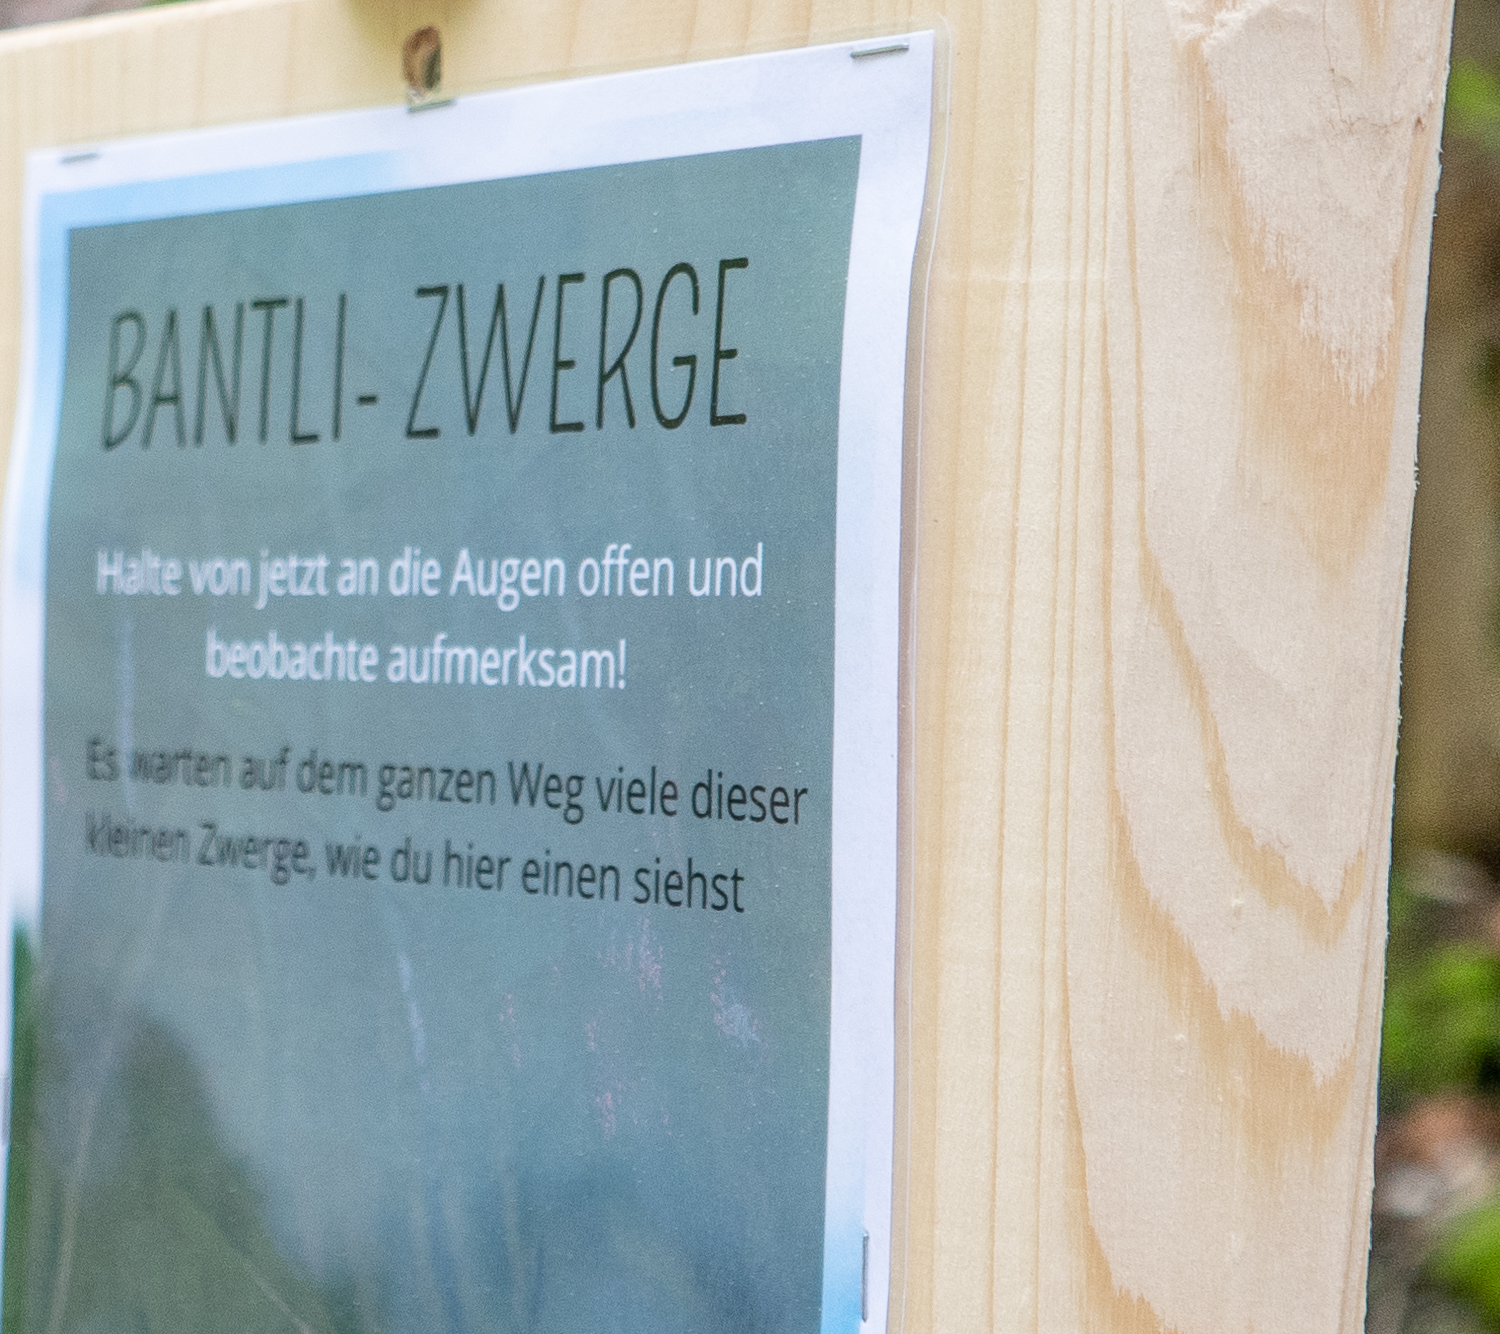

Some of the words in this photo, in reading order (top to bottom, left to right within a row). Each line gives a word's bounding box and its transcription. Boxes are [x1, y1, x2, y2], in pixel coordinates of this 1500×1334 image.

[405, 256, 750, 439] ZWERGE
[95, 544, 184, 597] Halte
[189, 557, 250, 597] von
[253, 544, 330, 610] jetzt
[337, 556, 380, 597] an
[389, 544, 443, 597] die
[449, 547, 567, 612] Augen
[576, 542, 676, 598] offen
[687, 539, 764, 598] und
[204, 624, 380, 682] beobachte
[386, 631, 628, 691] aufmerksam!
[85, 737, 121, 783] Es
[128, 745, 232, 789] warten
[239, 744, 292, 791] auf
[296, 747, 368, 796] dem
[375, 761, 497, 813] ganzen
[505, 759, 586, 826] Weg
[595, 764, 680, 818] viele
[690, 767, 809, 827] dieser
[84, 809, 191, 864] kleinen
[196, 821, 317, 887] Zwerge,
[324, 831, 382, 881] wie
[389, 834, 434, 886] du
[442, 837, 513, 893] hier
[520, 847, 622, 903] einen
[631, 855, 747, 915] siehst
